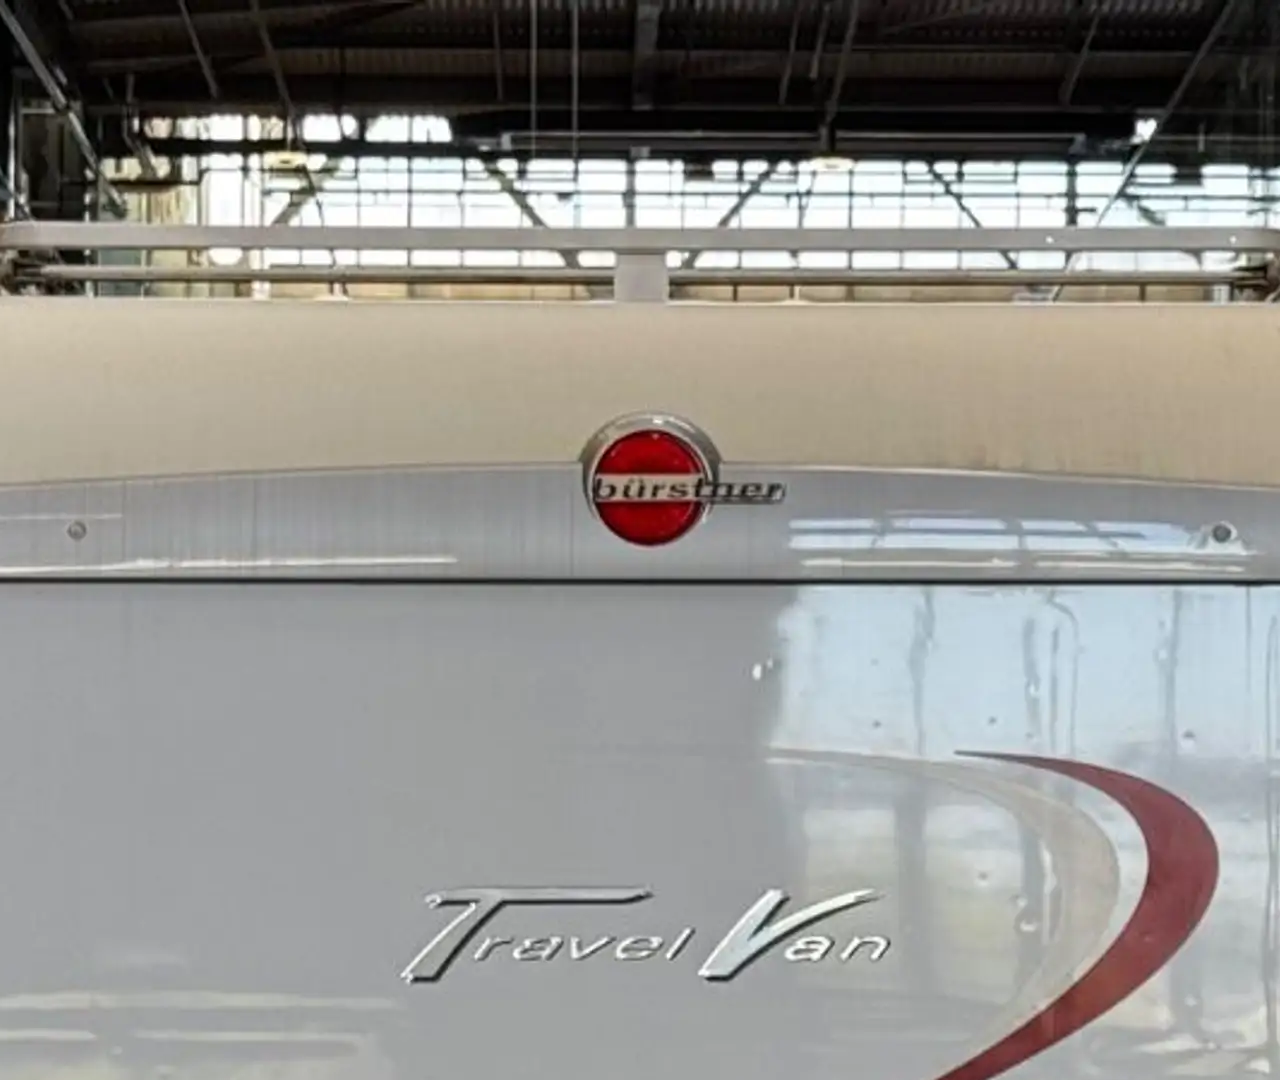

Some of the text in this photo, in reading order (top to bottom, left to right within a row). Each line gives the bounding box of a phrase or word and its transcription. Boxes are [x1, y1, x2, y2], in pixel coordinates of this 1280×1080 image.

[593, 476, 787, 503] bürstner
[400, 885, 893, 984] Travel Van
